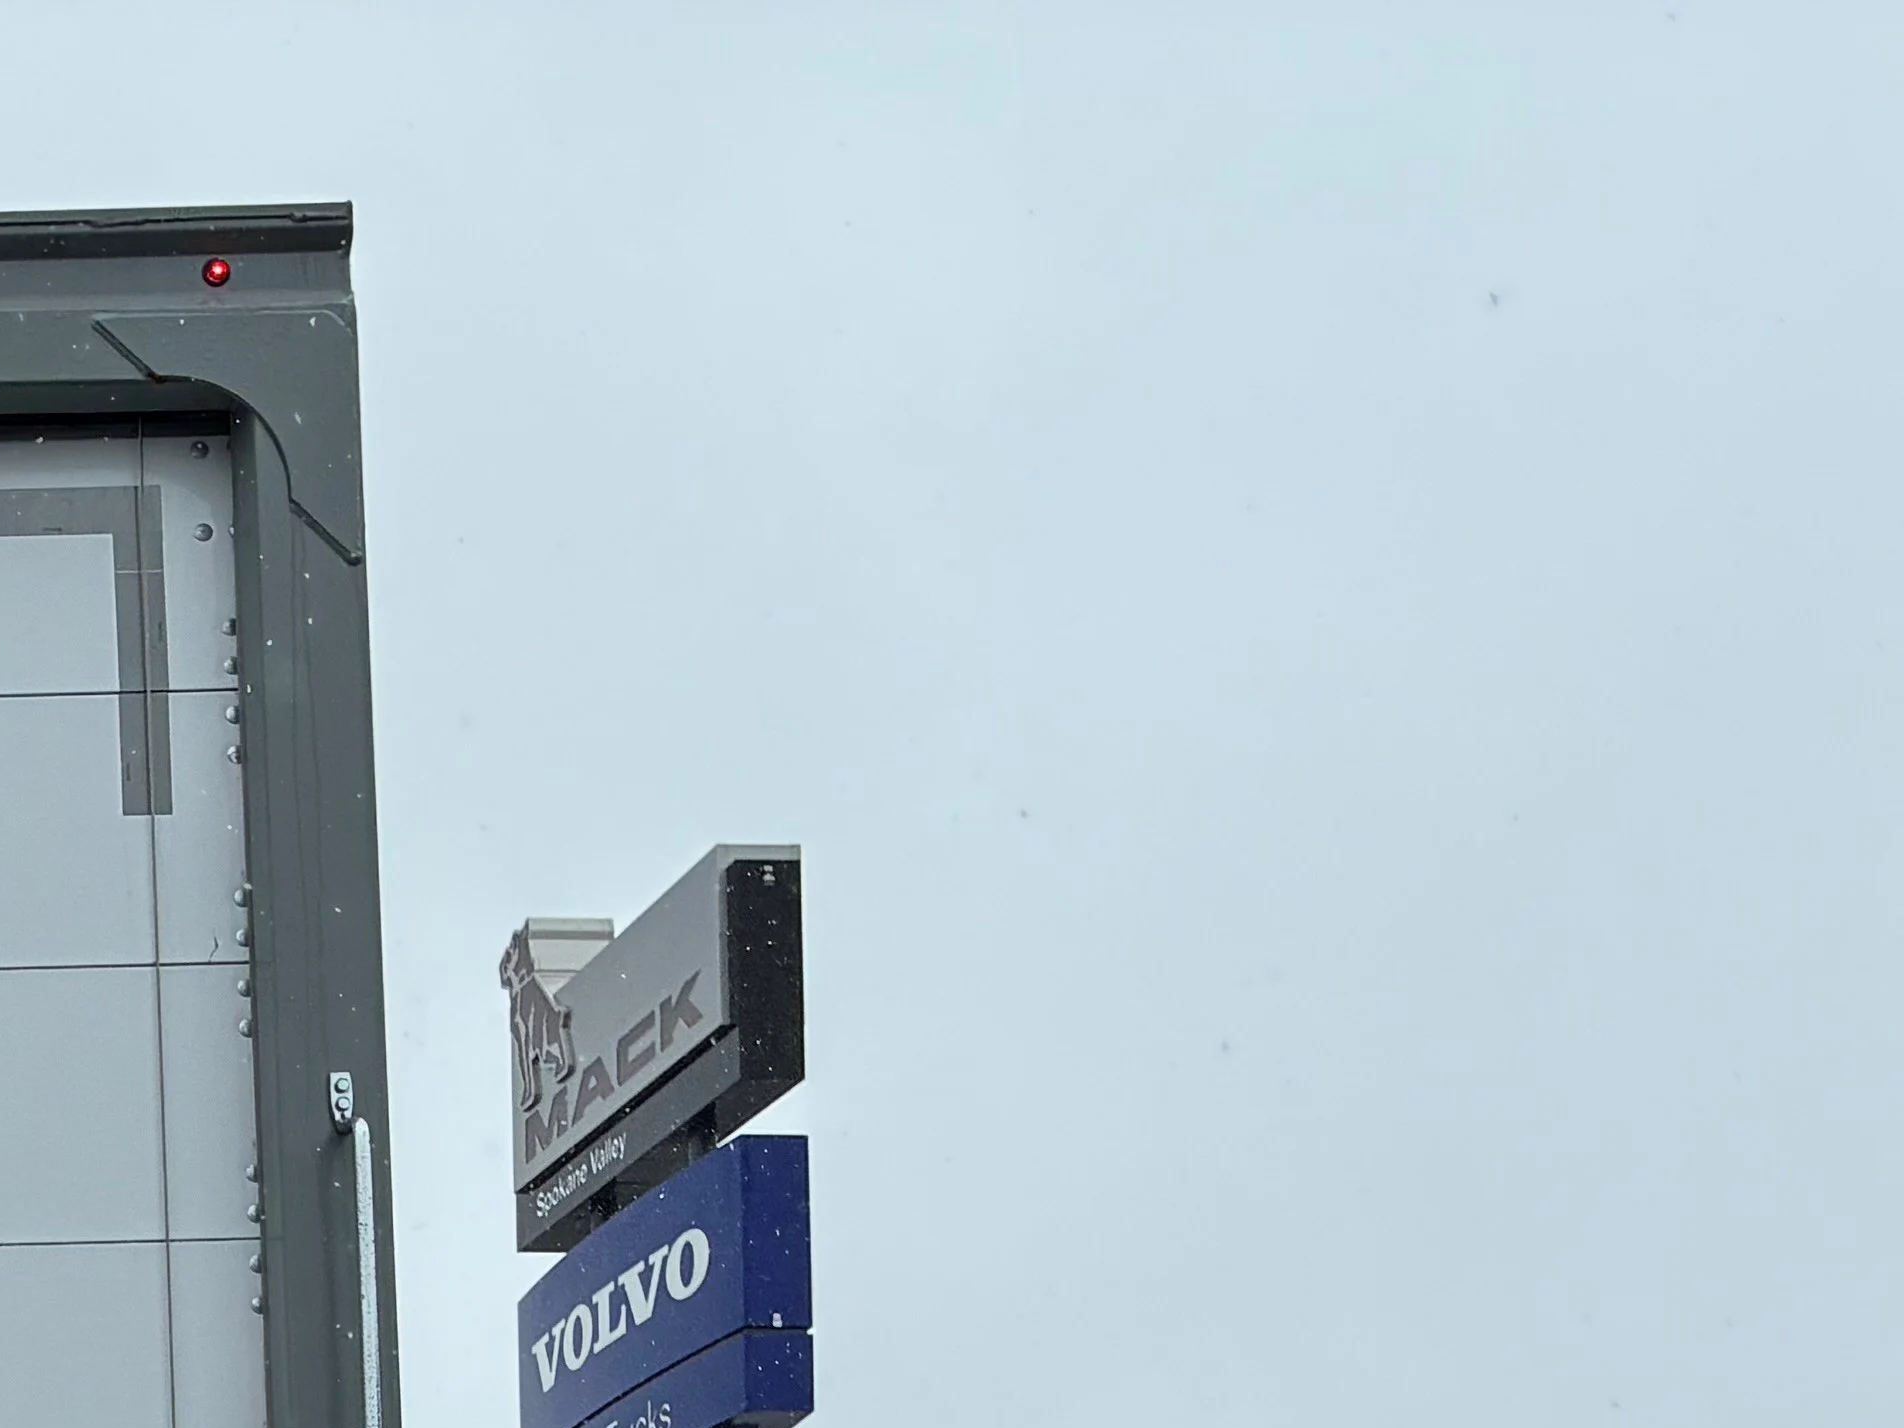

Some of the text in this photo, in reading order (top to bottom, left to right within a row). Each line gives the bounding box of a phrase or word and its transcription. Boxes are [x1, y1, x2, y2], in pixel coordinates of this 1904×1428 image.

[525, 968, 703, 1165] MACK
[536, 1132, 627, 1218] Spokane Valley
[532, 1228, 710, 1393] VOLVO
